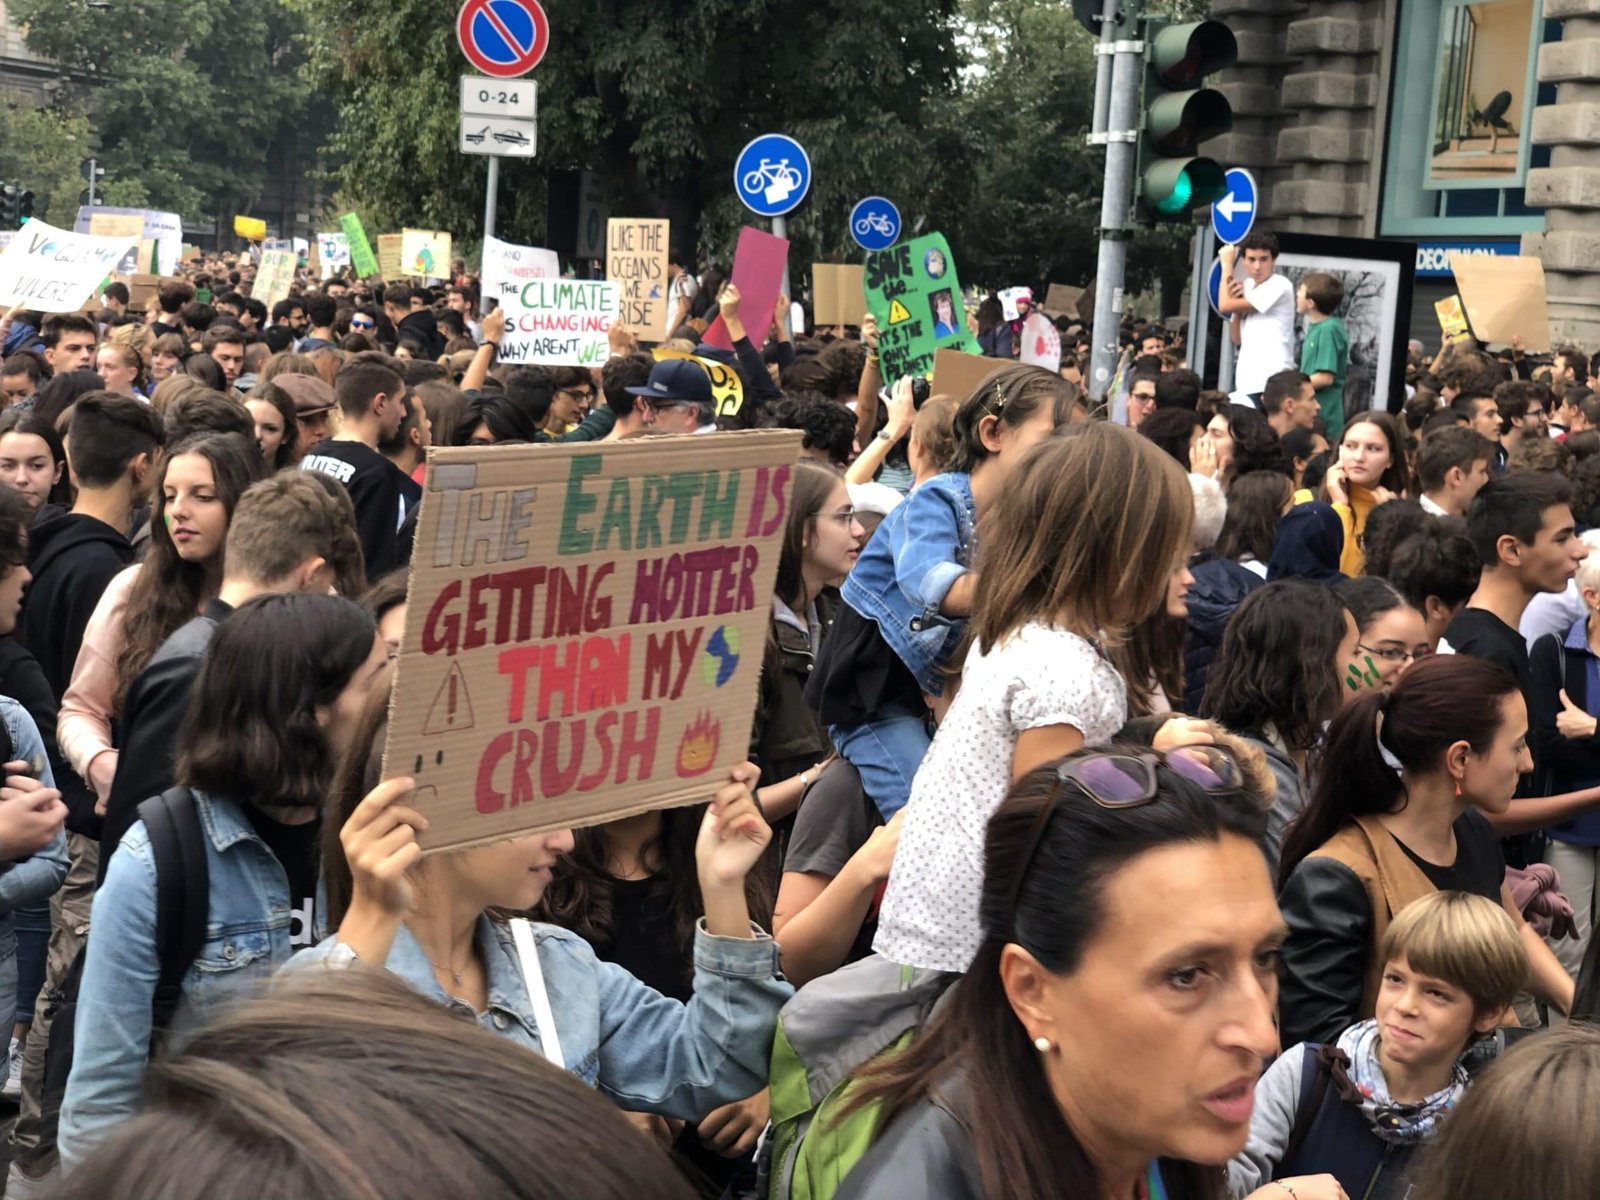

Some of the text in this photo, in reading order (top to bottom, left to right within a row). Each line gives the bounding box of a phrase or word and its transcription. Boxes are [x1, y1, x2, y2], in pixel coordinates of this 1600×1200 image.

[479, 90, 519, 104] 0-24
[611, 224, 663, 252] LIKE THE
[611, 256, 662, 280] OCEANS
[867, 246, 914, 290] SAVE
[500, 282, 613, 311] THE CLIMATE
[625, 281, 642, 298] WE
[504, 314, 611, 332] S CHANGING
[619, 299, 653, 326] RISE
[500, 342, 530, 360] WHY
[577, 340, 608, 364] WE
[431, 453, 791, 568] THE EARTH IS
[421, 544, 760, 657] GETTING HOTTER
[498, 626, 704, 723] THAN MY
[475, 706, 662, 814] CRUSH
